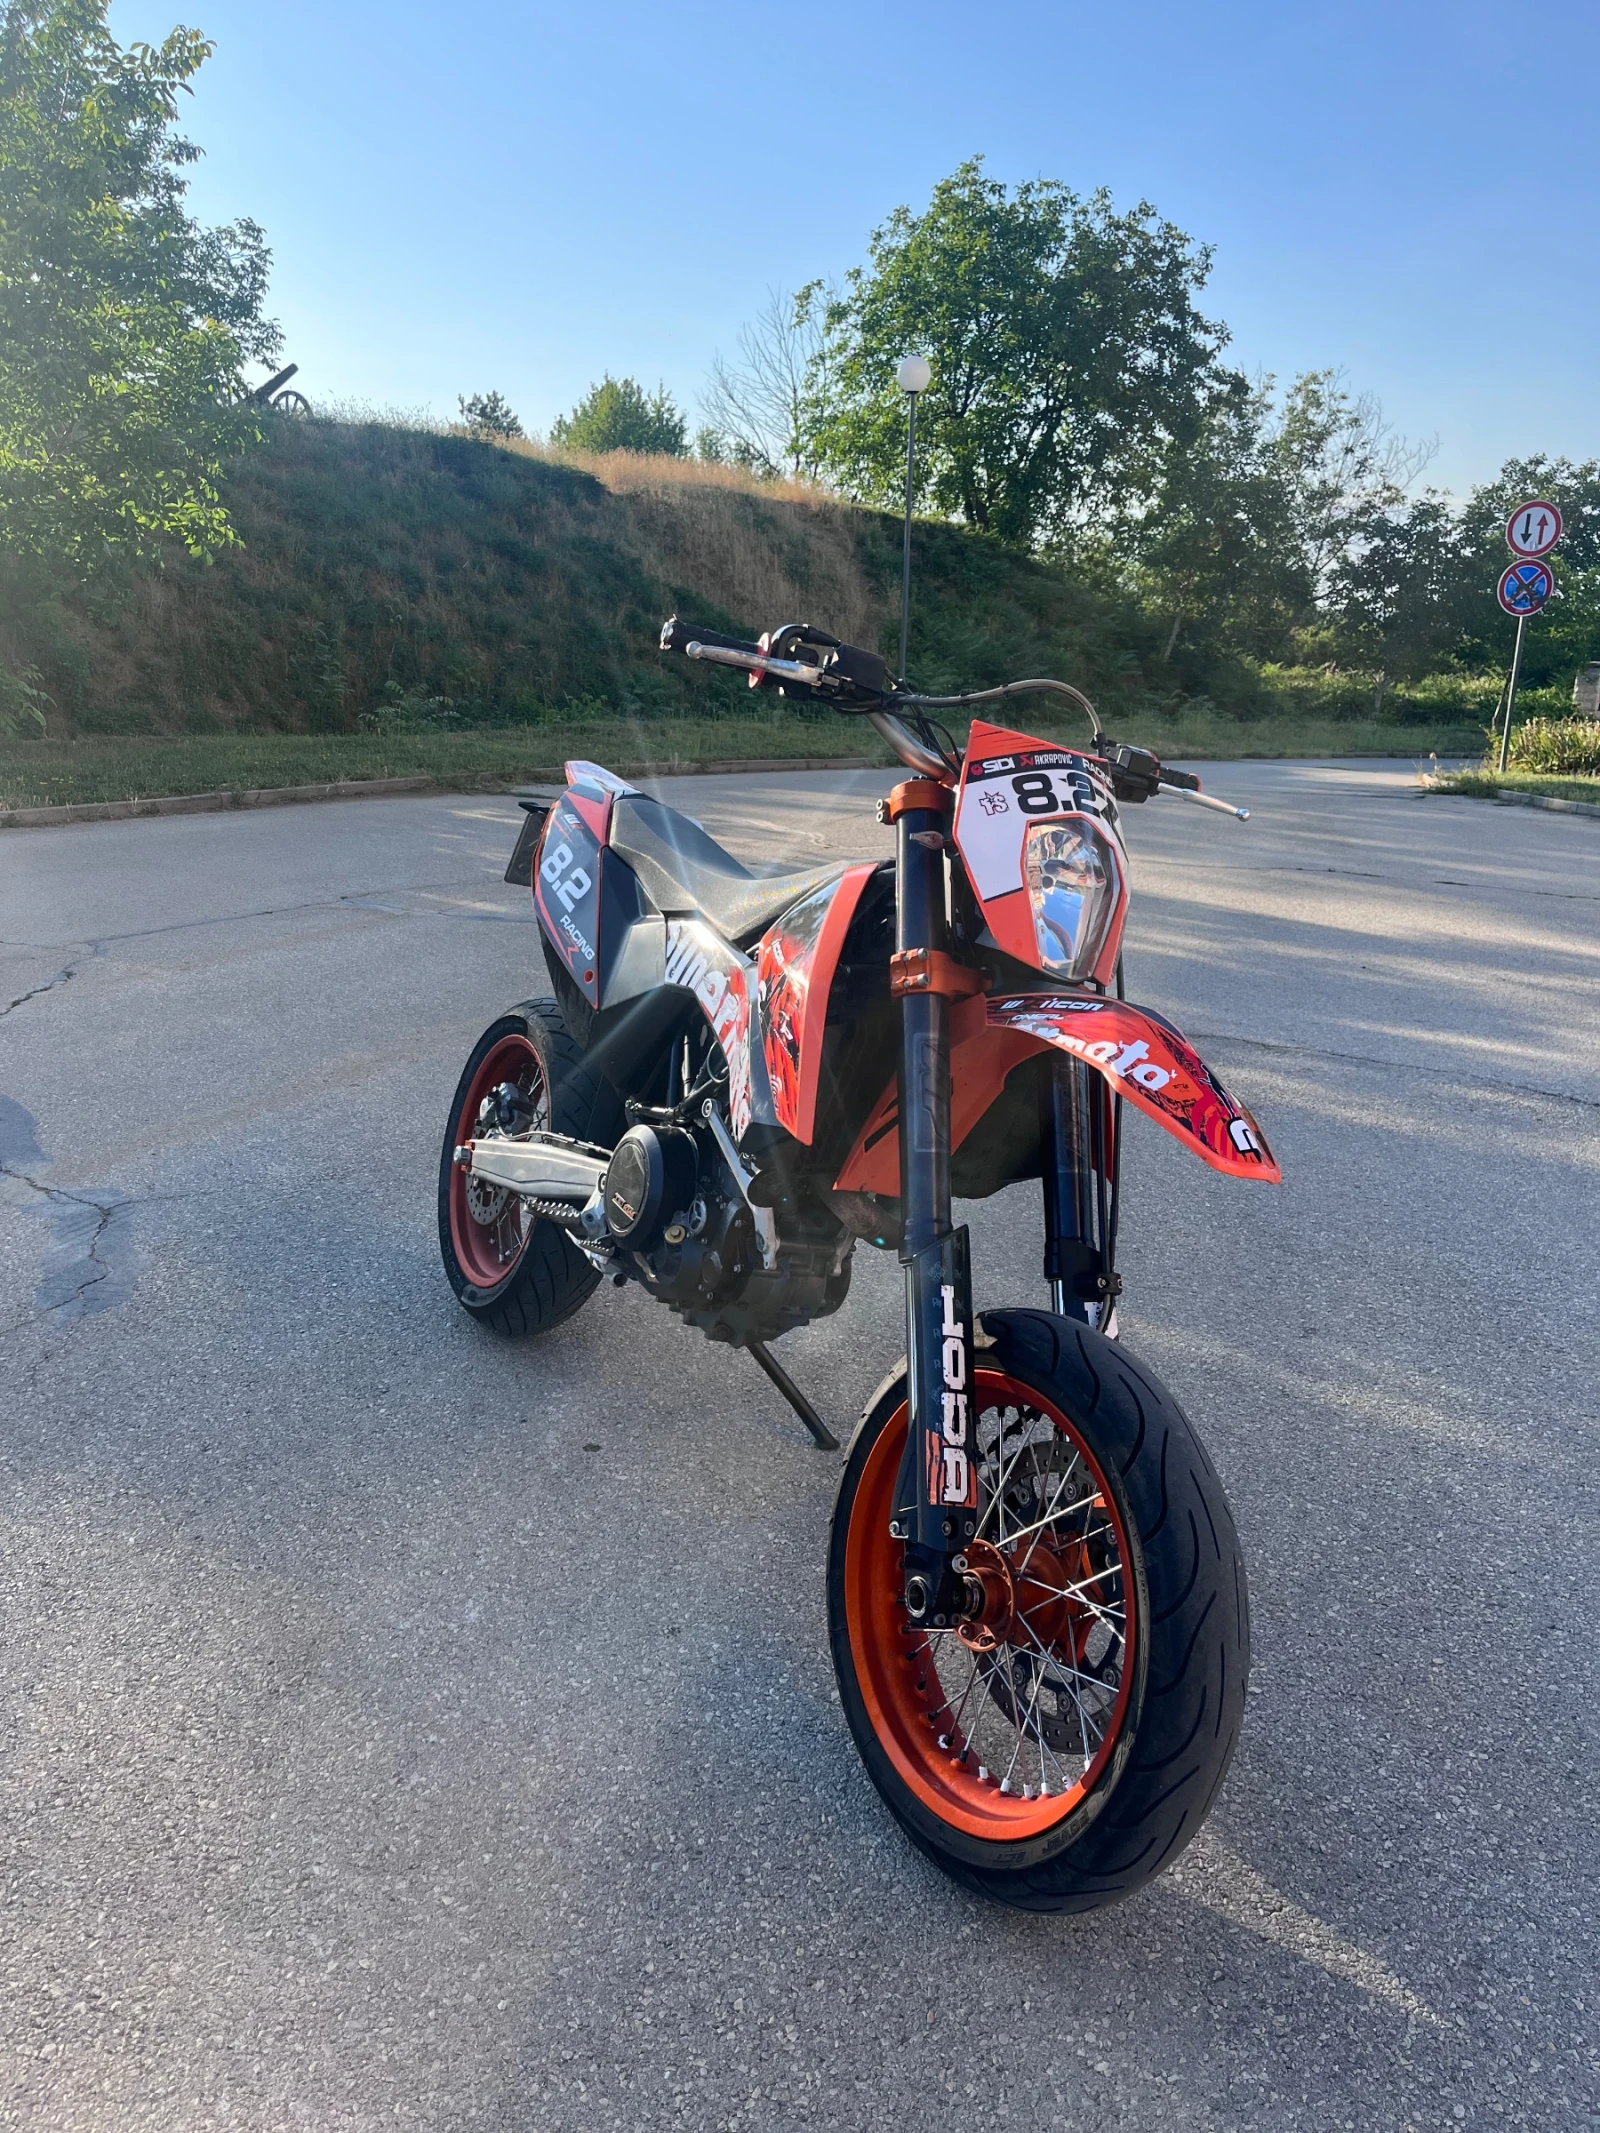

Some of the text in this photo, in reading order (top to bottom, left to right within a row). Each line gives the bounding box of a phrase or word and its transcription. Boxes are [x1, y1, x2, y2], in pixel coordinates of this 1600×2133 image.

[982, 757, 1015, 773] SIDI
[541, 843, 591, 913] 8.2
[560, 914, 595, 960] RACING
